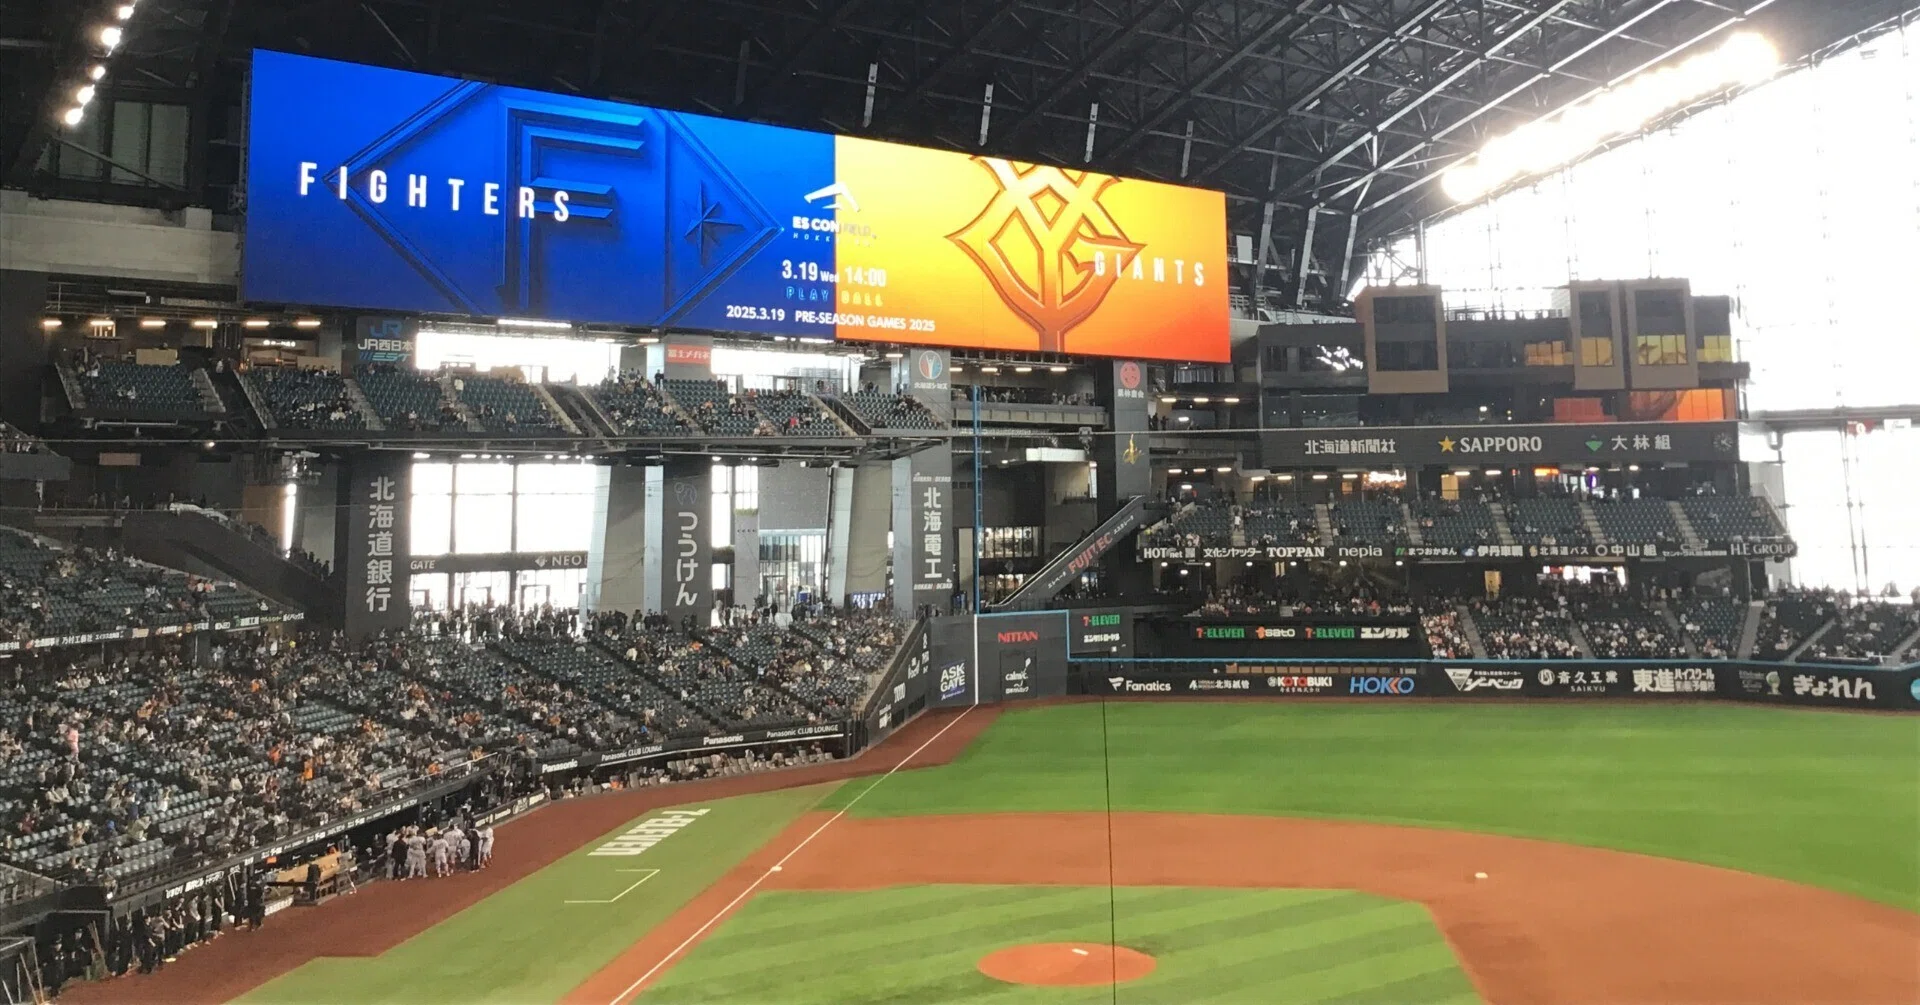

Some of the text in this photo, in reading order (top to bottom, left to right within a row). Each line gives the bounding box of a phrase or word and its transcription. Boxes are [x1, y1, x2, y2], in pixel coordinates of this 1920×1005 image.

[299, 161, 571, 223] FIGHTERS
[792, 215, 810, 230] ES
[811, 217, 840, 233] CON
[782, 259, 818, 281] 3.19
[844, 265, 887, 287] 14:00
[1094, 250, 1206, 287] GIANTS
[786, 286, 883, 307] PLAY BALL
[726, 304, 936, 331] 2025.3.19 PRE-SEASON GAMES 2025
[357, 338, 415, 352] JR西日本
[1304, 438, 1396, 455] 北海道新聞社
[1460, 436, 1542, 453] SAPPORO
[1611, 434, 1671, 451] 大林組
[923, 486, 943, 579] 北海電工
[366, 476, 396, 613] 北海道銀行
[1266, 546, 1325, 558] TOPPAN
[1338, 545, 1383, 558] nepia
[1408, 547, 1457, 556] まつおかまん
[1540, 546, 1589, 556] 北海道バス
[1610, 544, 1657, 557] 中山組
[1753, 543, 1794, 555] GROUP
[675, 511, 698, 606] つうけん
[1067, 532, 1113, 575] FUJITEC
[410, 560, 436, 570] GATE
[998, 631, 1038, 643] NITTAN
[941, 663, 965, 682] ASK
[1632, 669, 1675, 692] 東進
[1674, 668, 1715, 680] ハイスクール
[940, 675, 966, 692] GATE
[1126, 680, 1171, 691] Fanatics
[1277, 676, 1332, 688] KOTOBUKI
[1793, 674, 1876, 700] ぎょれん
[766, 724, 839, 738] Panasonic CLUB LOUNGE
[703, 734, 744, 746] Panasonic
[601, 751, 628, 762] Panasonic
[628, 748, 642, 757] CLUB
[541, 759, 578, 774] Panasonic
